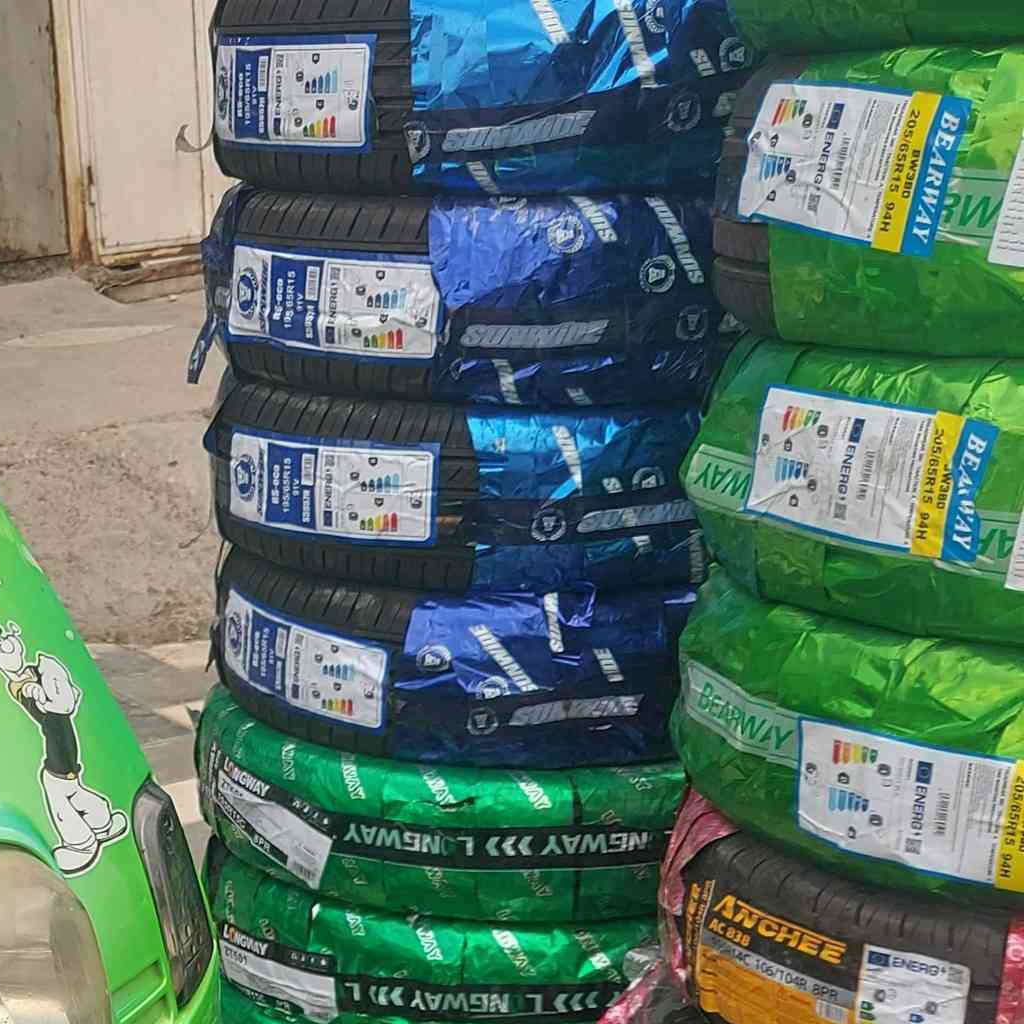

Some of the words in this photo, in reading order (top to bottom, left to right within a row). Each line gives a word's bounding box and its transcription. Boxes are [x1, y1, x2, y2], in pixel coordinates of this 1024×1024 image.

[812, 131, 835, 187] ENERG
[888, 108, 921, 194] 205/65R15
[910, 109, 961, 244] BEARWAY
[879, 201, 896, 233] 94H
[837, 443, 857, 496] ENERG
[915, 512, 931, 540] 94H
[223, 756, 271, 797] LONGWAY
[910, 785, 929, 830] ENERG
[343, 822, 475, 857] LNGWAY
[540, 831, 650, 857] NGWAY
[223, 923, 269, 956] LONGWAY
[713, 894, 847, 965] ANCHEE
[891, 956, 940, 977] ENERG
[410, 989, 546, 1014] LNGWAY
